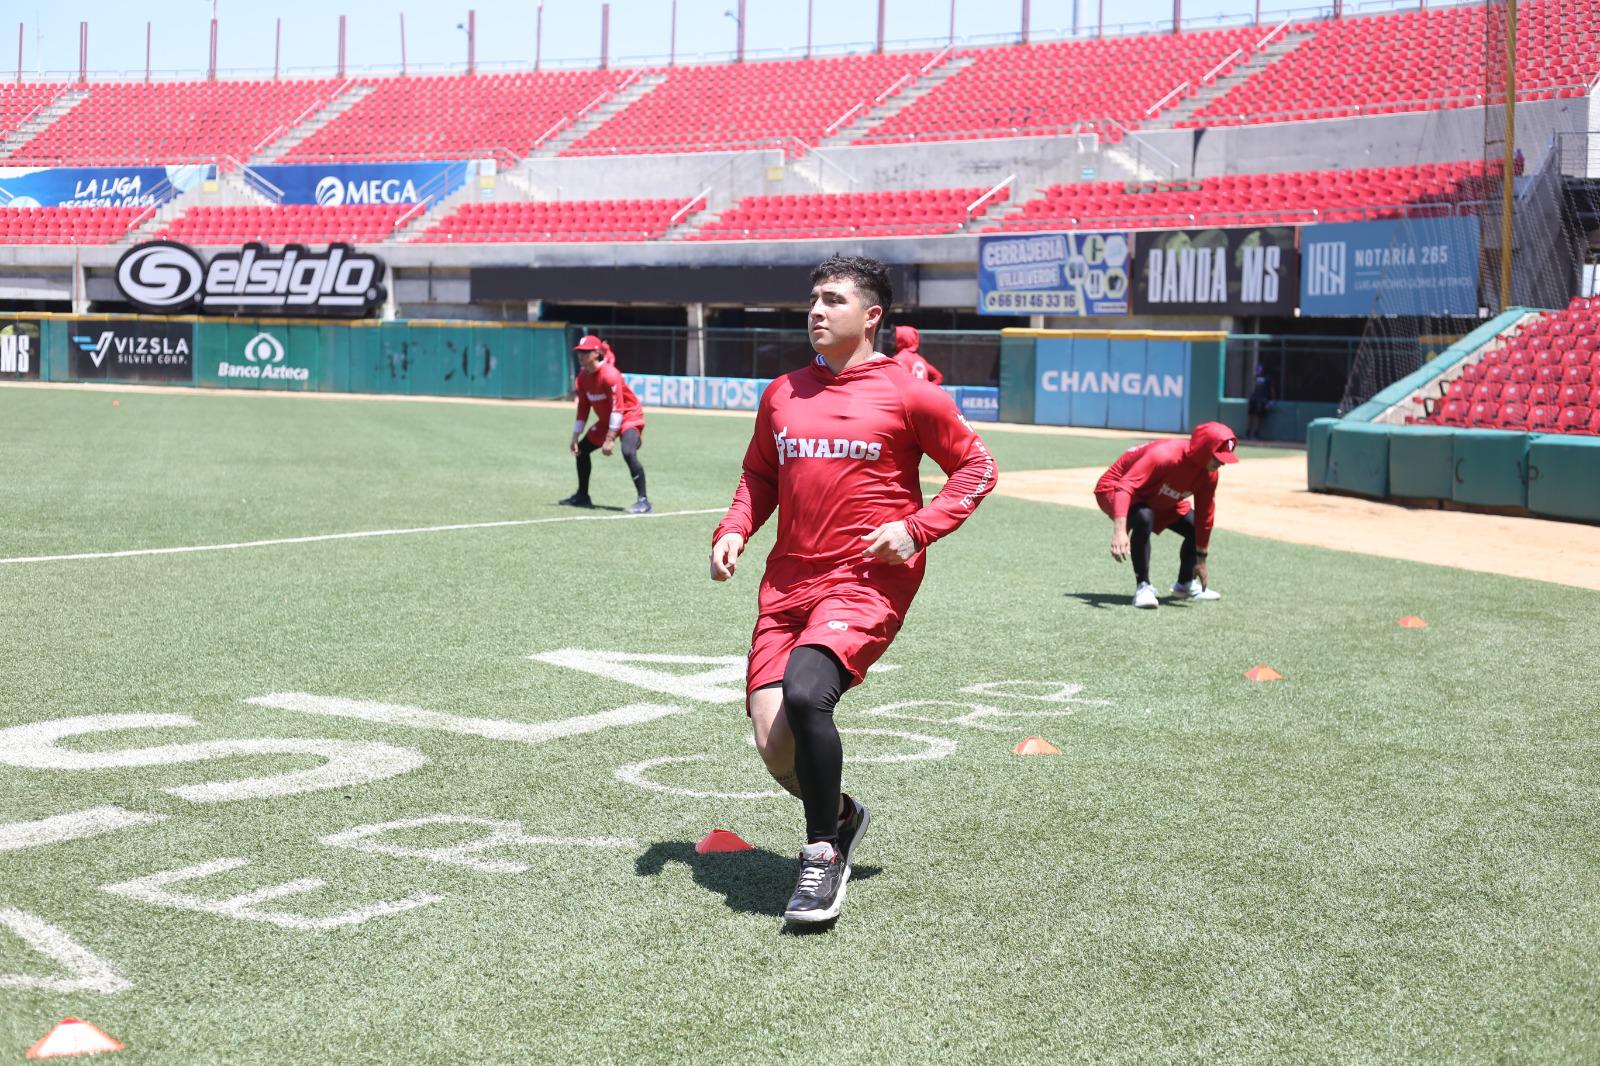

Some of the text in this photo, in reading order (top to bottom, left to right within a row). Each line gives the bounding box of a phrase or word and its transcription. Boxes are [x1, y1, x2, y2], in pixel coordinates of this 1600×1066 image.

[75, 175, 141, 199] LA LIGA
[346, 179, 417, 204] MEGA
[1354, 243, 1449, 267] NOTARÍA 265
[1148, 246, 1228, 303] BANDA
[1241, 245, 1281, 303] MS
[1014, 293, 1027, 307] 91
[1045, 293, 1060, 306] 33
[0, 335, 30, 373] MS
[114, 337, 190, 355] VIZSLA
[118, 354, 153, 365] SILVER
[218, 362, 310, 381] Banco Azteca
[629, 376, 758, 408] CERRITOS
[1041, 370, 1184, 398] CHANGAN
